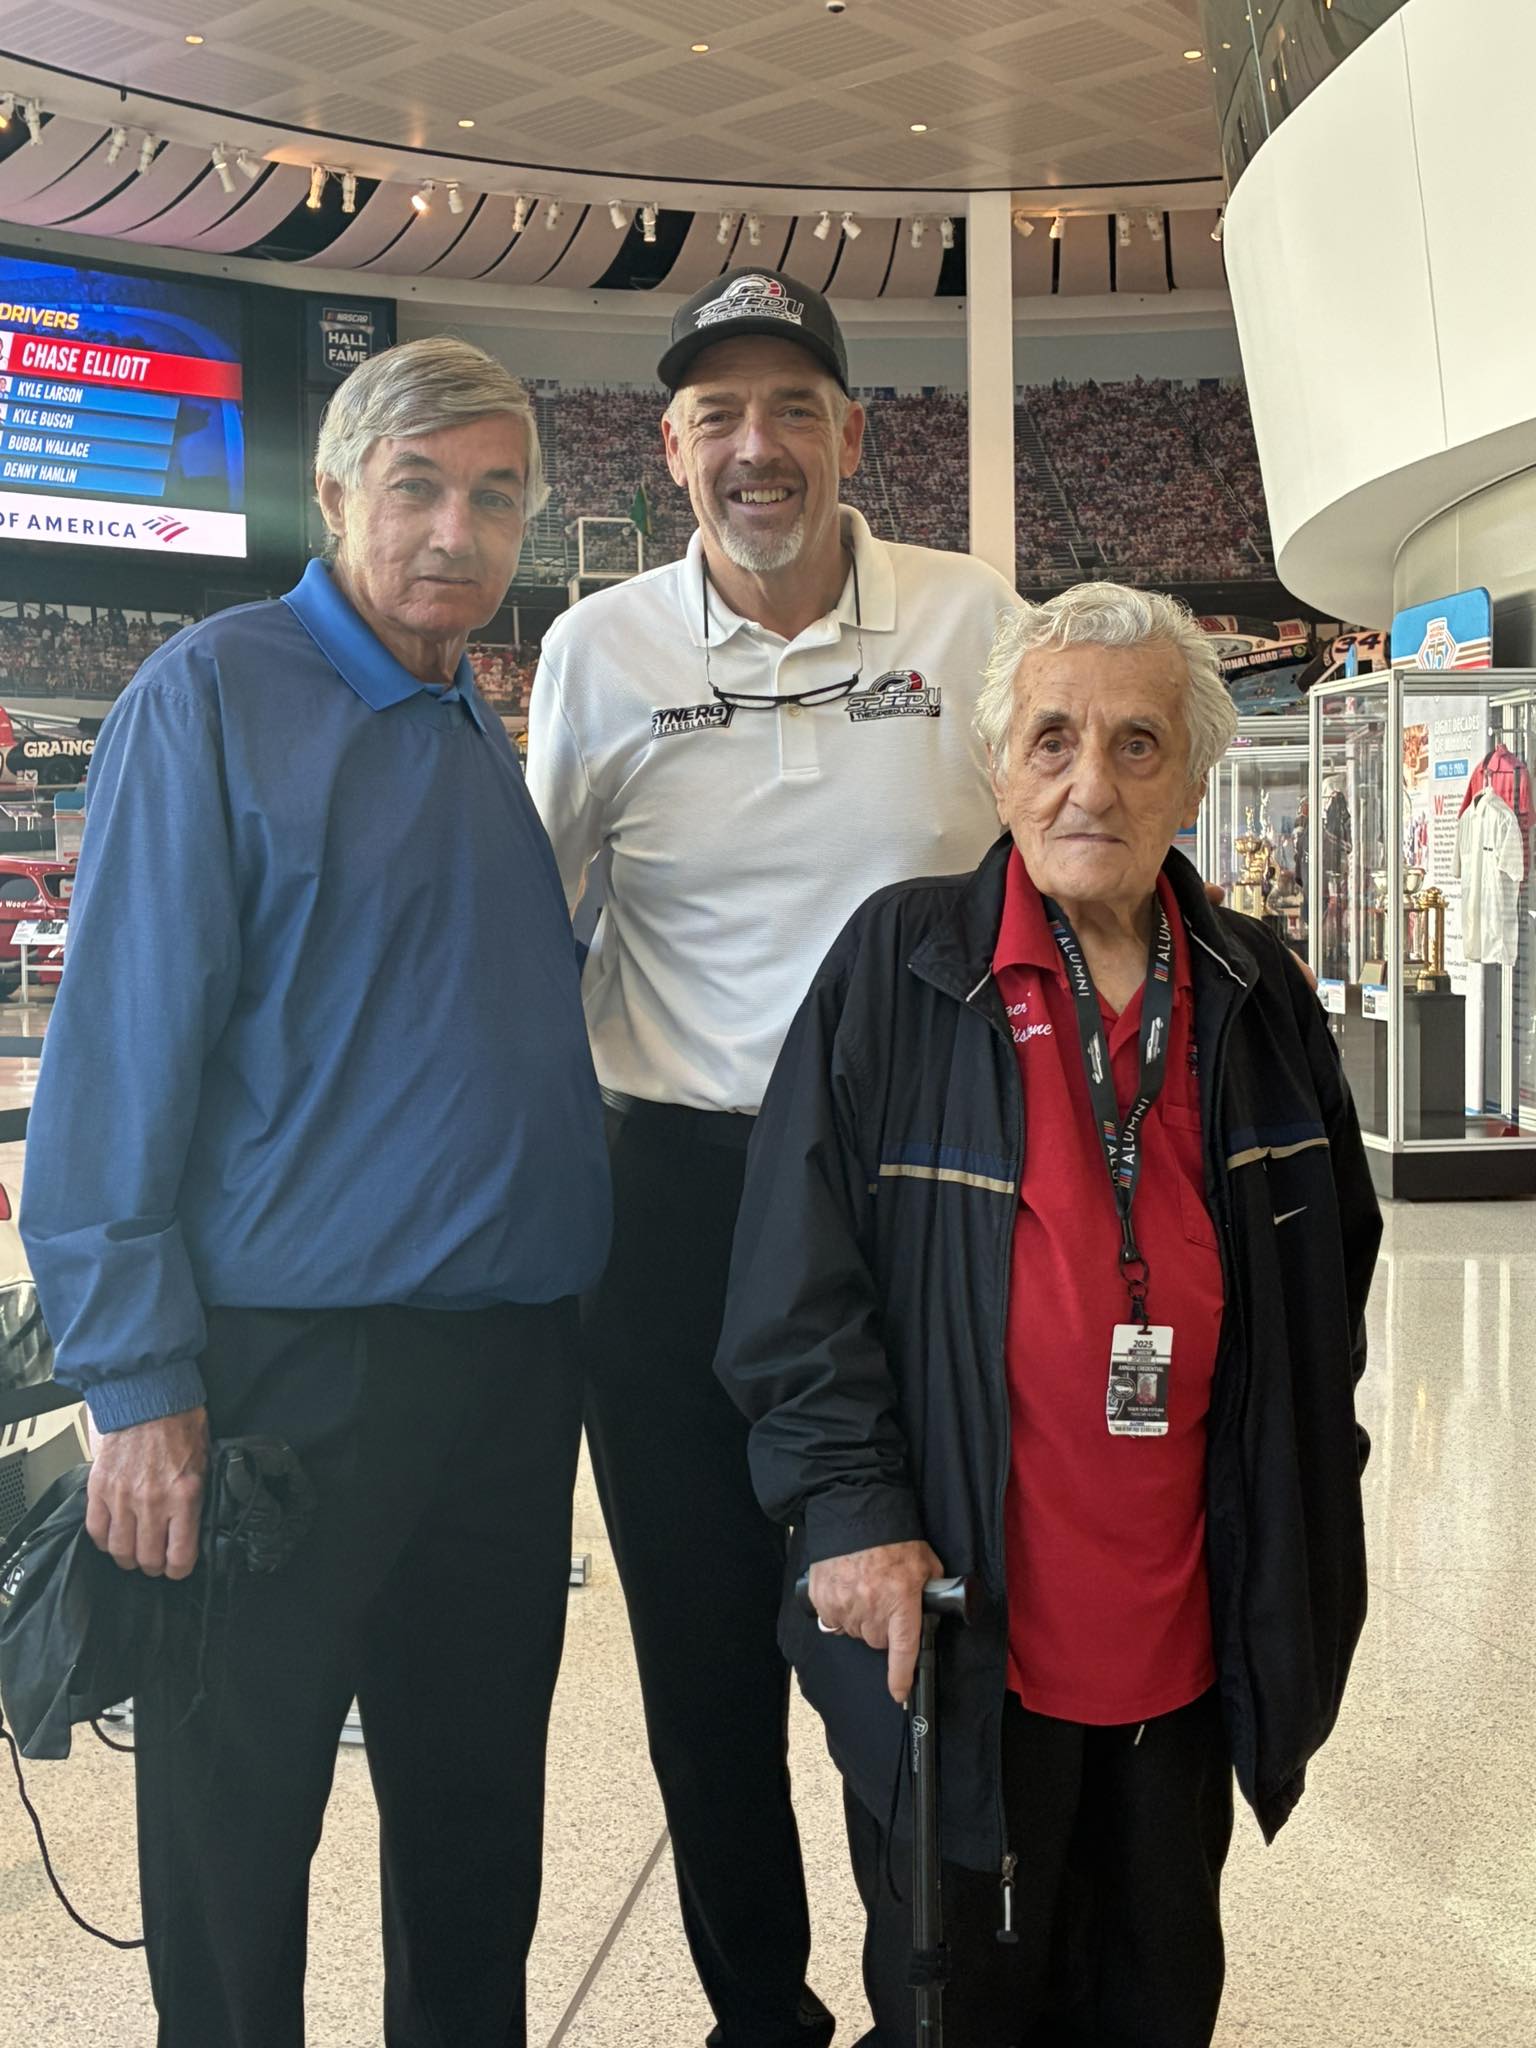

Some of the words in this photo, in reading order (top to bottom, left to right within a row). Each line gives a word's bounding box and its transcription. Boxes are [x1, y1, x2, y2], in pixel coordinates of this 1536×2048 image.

[0, 303, 80, 330] DRIVERS
[336, 313, 368, 323] NASCAR
[328, 332, 367, 346] HALL
[22, 341, 81, 373] CHASE
[82, 349, 151, 382] ELLIOTT
[328, 348, 367, 362] FAME
[17, 381, 43, 399] KYLE
[43, 384, 84, 404] LARSON
[12, 408, 38, 425] KYLE
[39, 411, 75, 429] BUSCH
[8, 435, 42, 453] BUBBA
[45, 438, 90, 458] WALLACE
[3, 461, 38, 480] DENNY
[39, 464, 78, 483] HAMLIN
[27, 514, 137, 539] AMERICA
[1335, 633, 1381, 653] 34
[1248, 650, 1278, 665] GUARD
[1057, 936, 1091, 996] ALUMNI
[1121, 1097, 1150, 1165] ALUMNI
